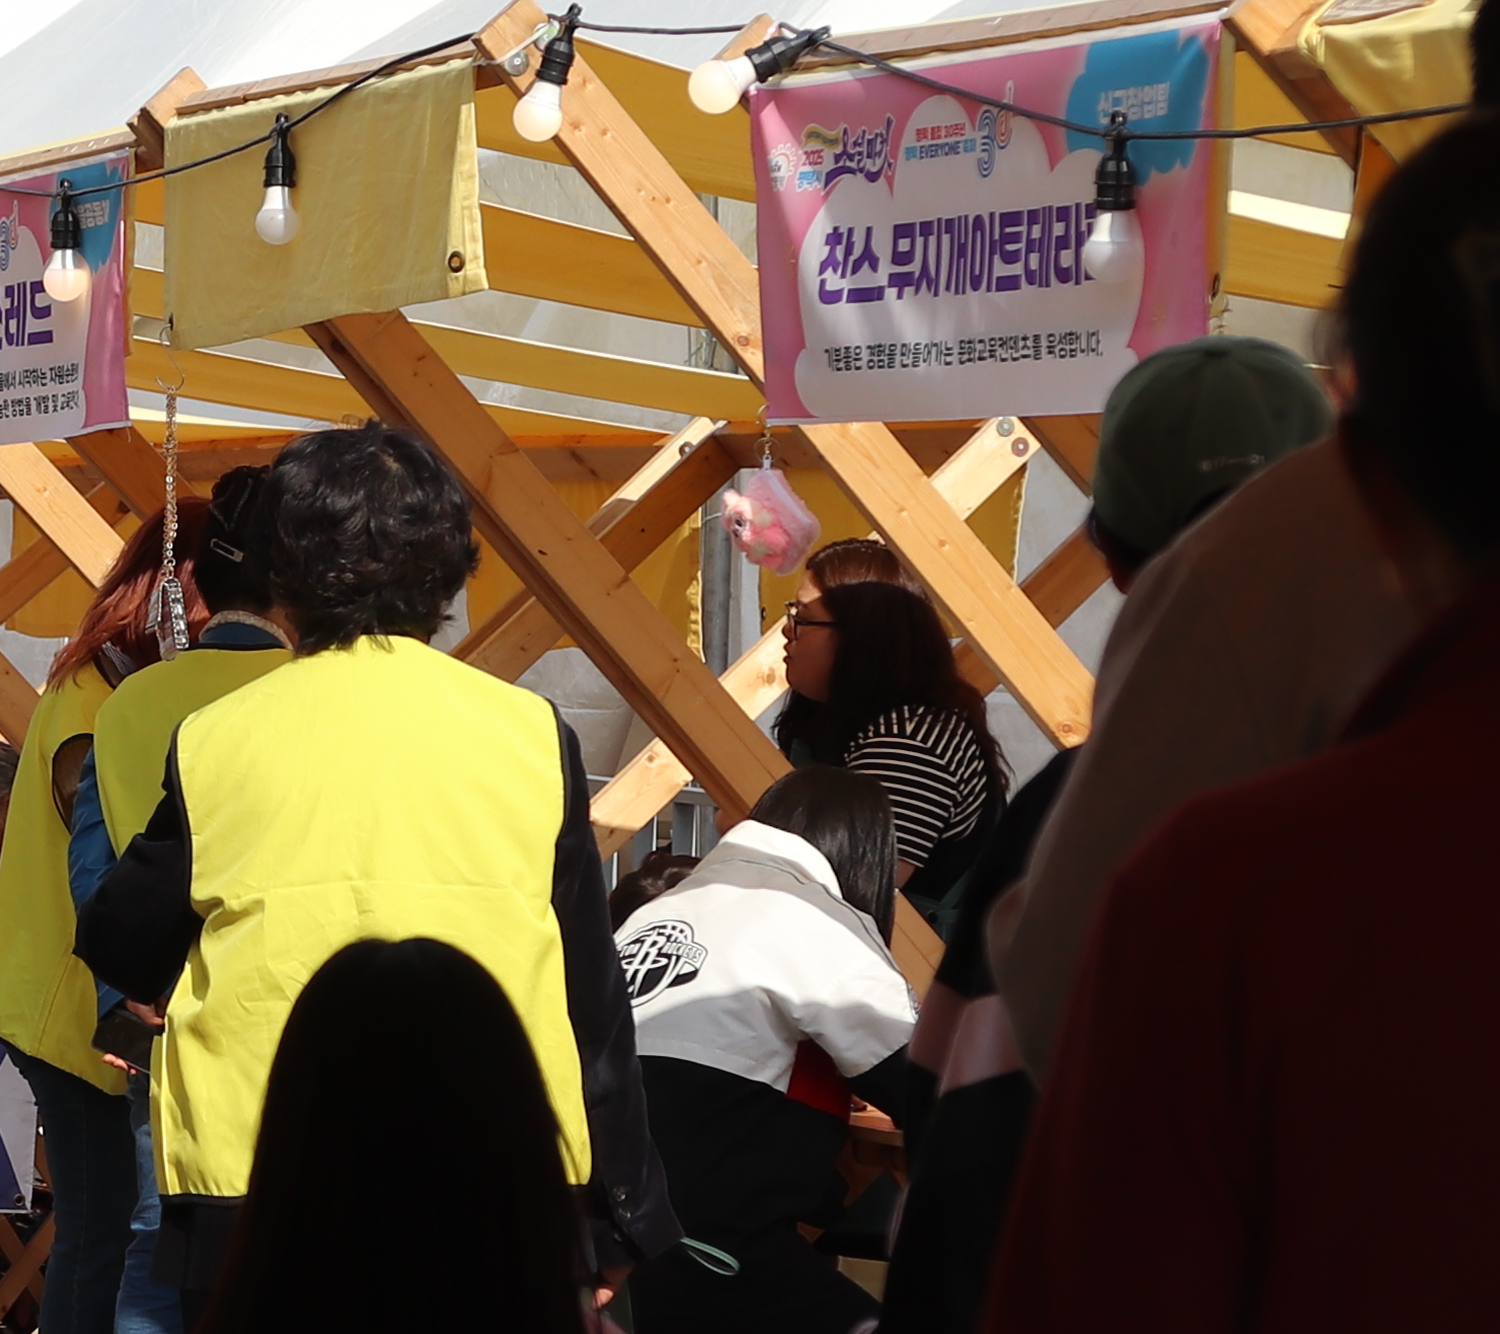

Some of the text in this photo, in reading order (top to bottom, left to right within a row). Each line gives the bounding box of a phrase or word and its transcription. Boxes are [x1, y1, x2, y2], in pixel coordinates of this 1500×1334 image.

[818, 225, 887, 306] 찬스
[865, 342, 898, 371] 경험을
[899, 339, 954, 369] 만들어가는
